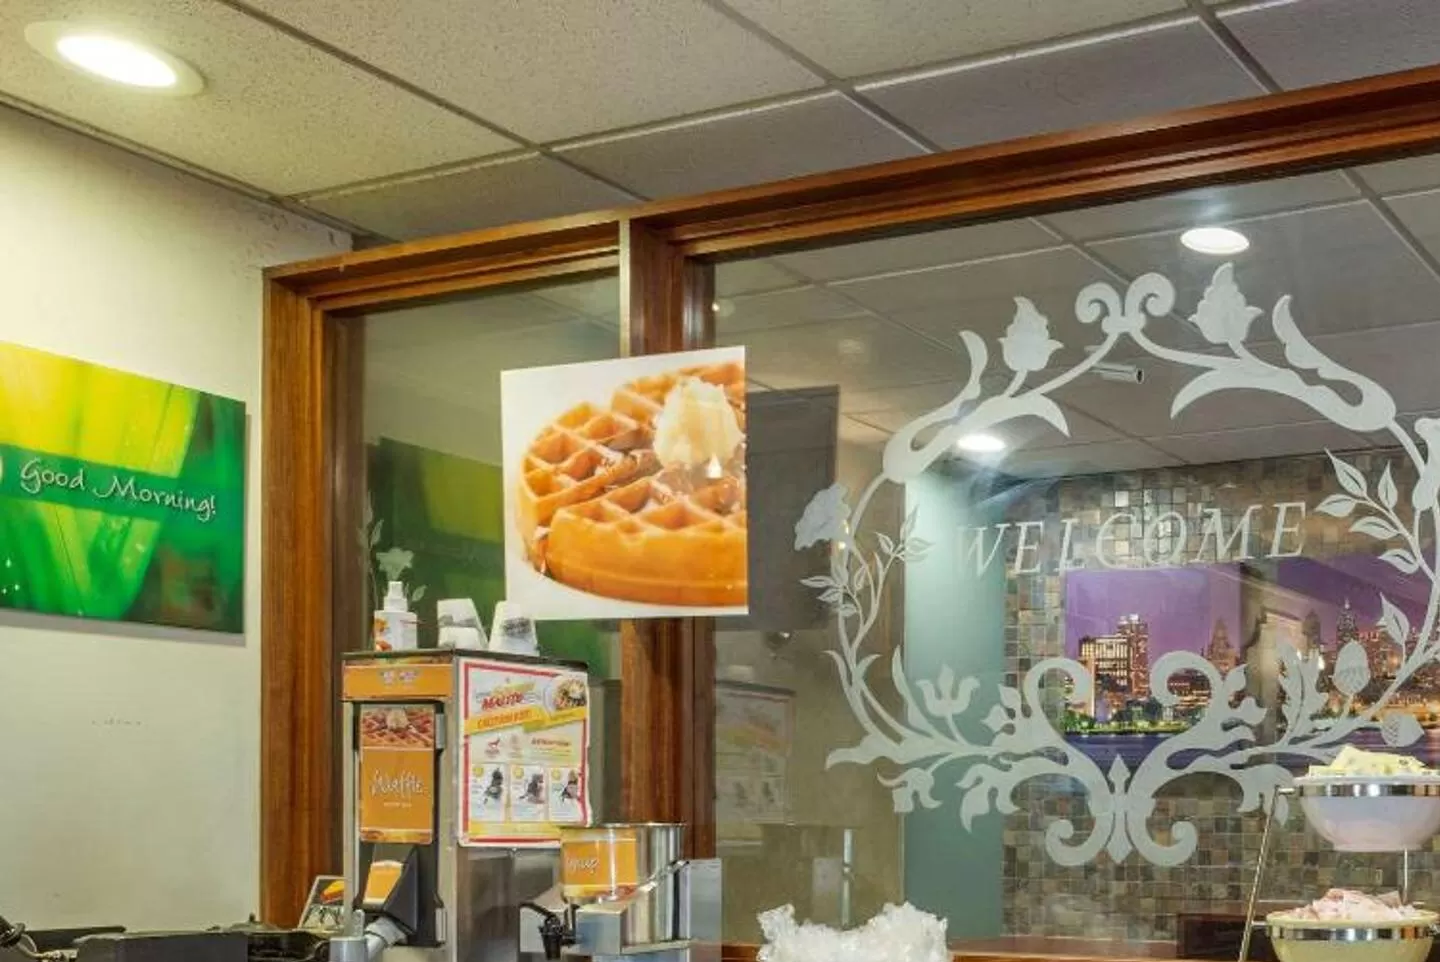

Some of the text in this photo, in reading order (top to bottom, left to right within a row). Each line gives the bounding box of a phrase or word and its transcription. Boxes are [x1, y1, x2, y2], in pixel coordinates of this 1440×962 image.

[20, 457, 217, 523] Good Morning!
[957, 501, 1307, 578] WELCOME
